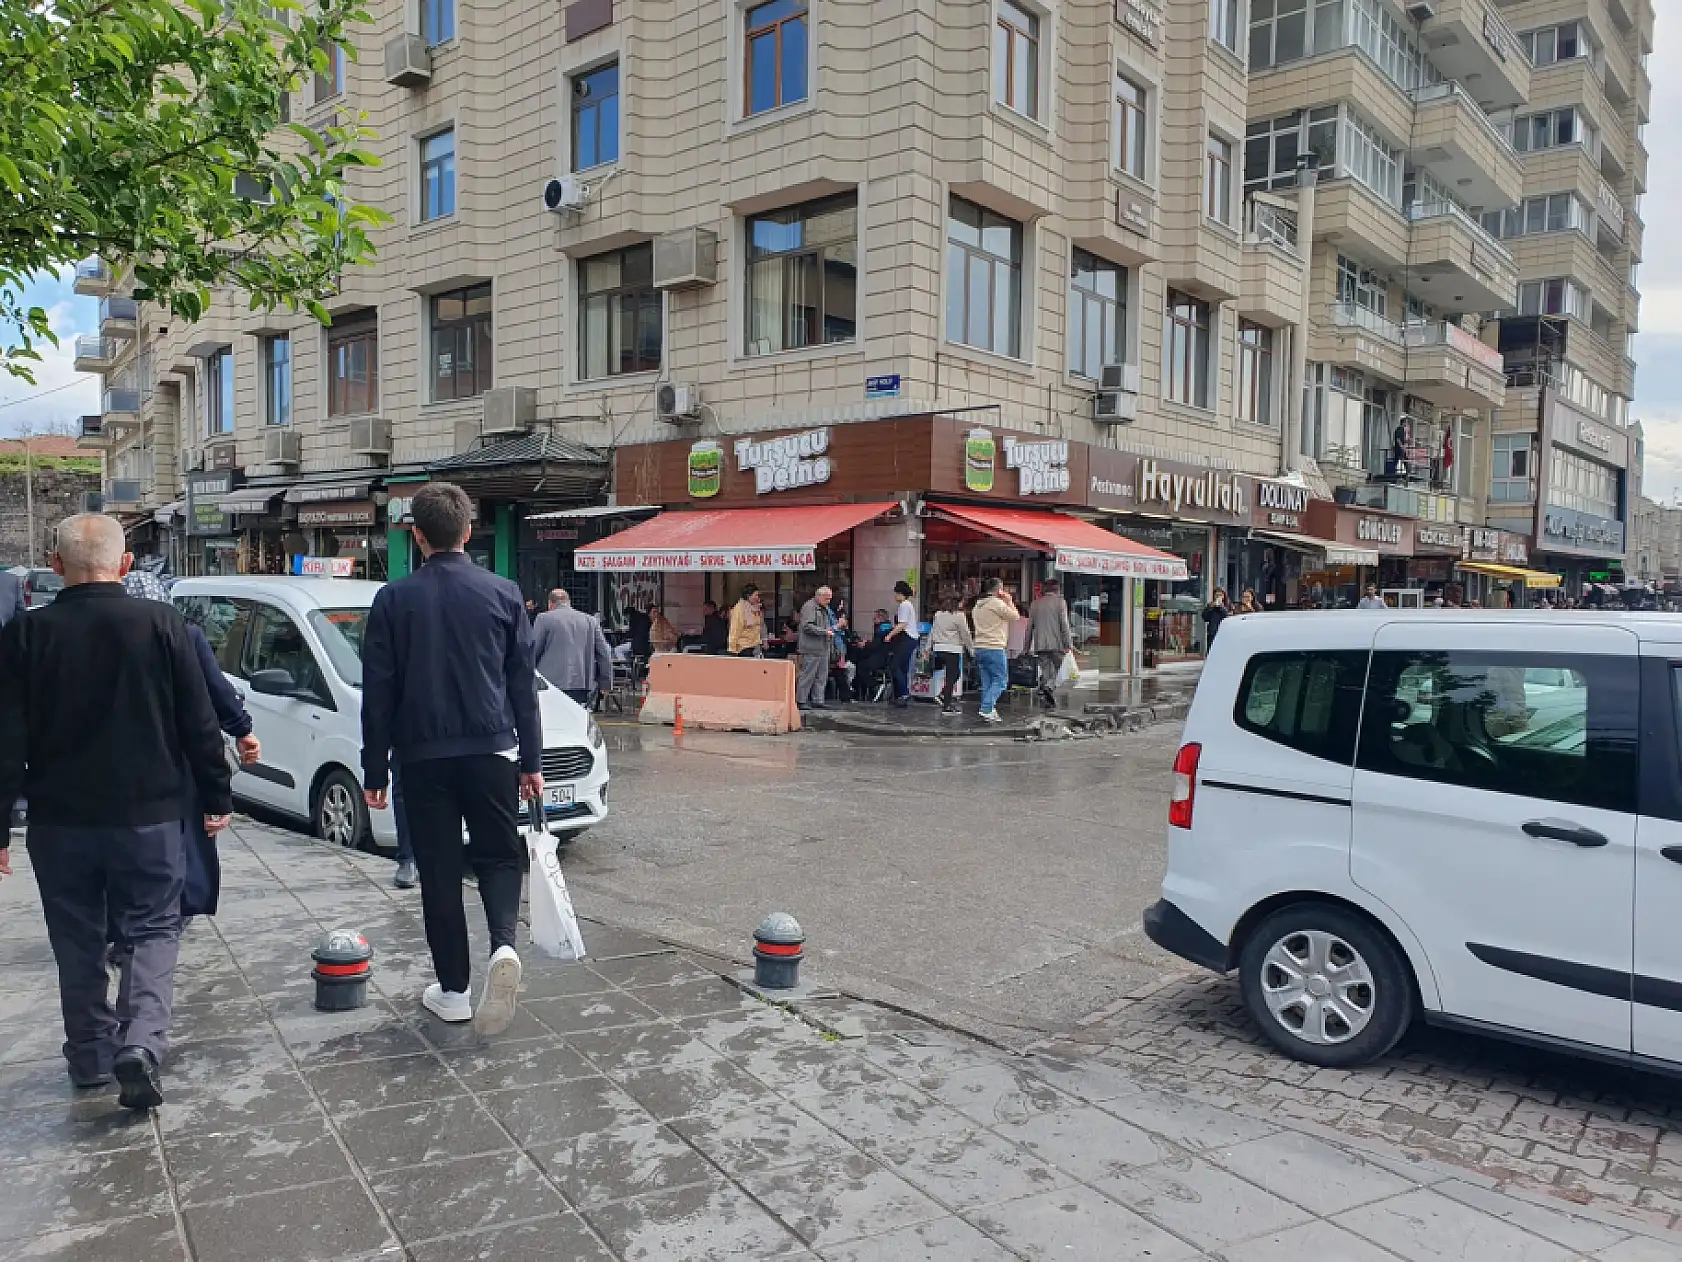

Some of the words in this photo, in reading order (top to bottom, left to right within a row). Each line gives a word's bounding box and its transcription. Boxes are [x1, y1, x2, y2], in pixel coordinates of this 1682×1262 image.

[756, 453, 831, 495] Defne
[1137, 458, 1243, 516] Hayrullah
[781, 553, 813, 568] SALÇA
[551, 787, 571, 803] 504
